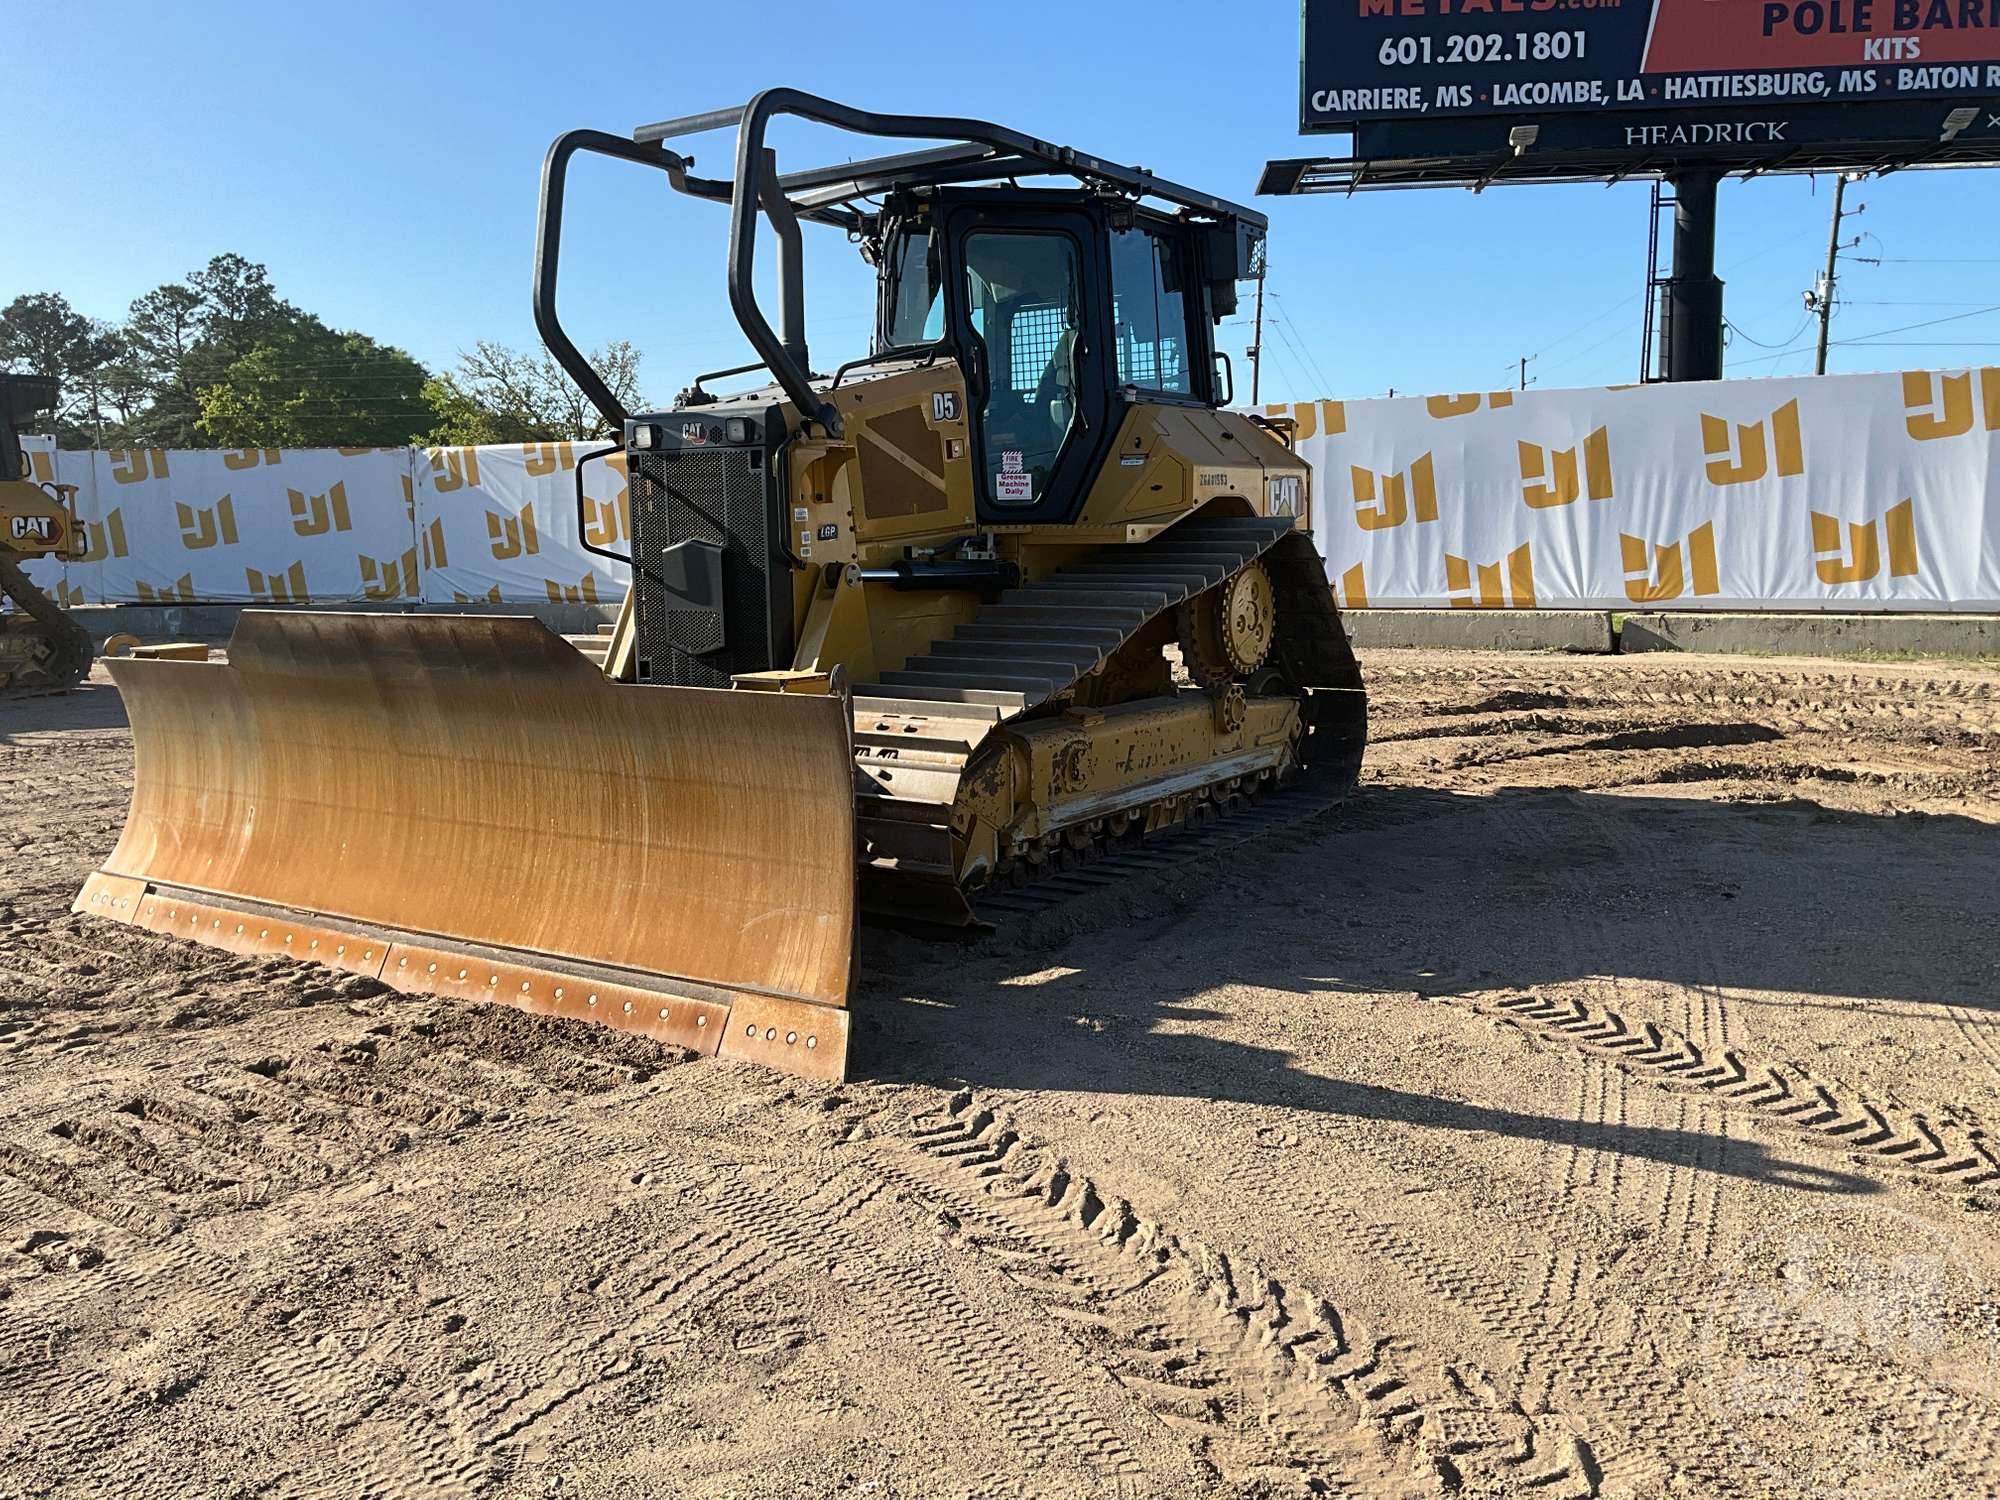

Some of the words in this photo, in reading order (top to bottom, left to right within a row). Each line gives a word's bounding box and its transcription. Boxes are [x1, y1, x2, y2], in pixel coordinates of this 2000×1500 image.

[1763, 1, 1873, 37] POLE
[1893, 0, 2000, 32] BAR
[1378, 31, 1586, 65] 601.202.1801
[1864, 36, 1921, 61] KITS
[1311, 88, 1429, 112] CARRIERE,
[1436, 85, 1473, 107] MS
[1493, 80, 1610, 106] LACOMBE,
[1617, 79, 1644, 101] LA
[1664, 71, 1831, 100] HATTIESBURG,
[1838, 69, 1877, 93] MS
[1898, 66, 1978, 91] BATON
[1624, 121, 1789, 145] HEADRICK
[933, 392, 954, 420] D5
[682, 422, 702, 440] CAT
[1269, 477, 1299, 518] CAT
[11, 516, 51, 539] CAT
[820, 526, 836, 538] LGP
